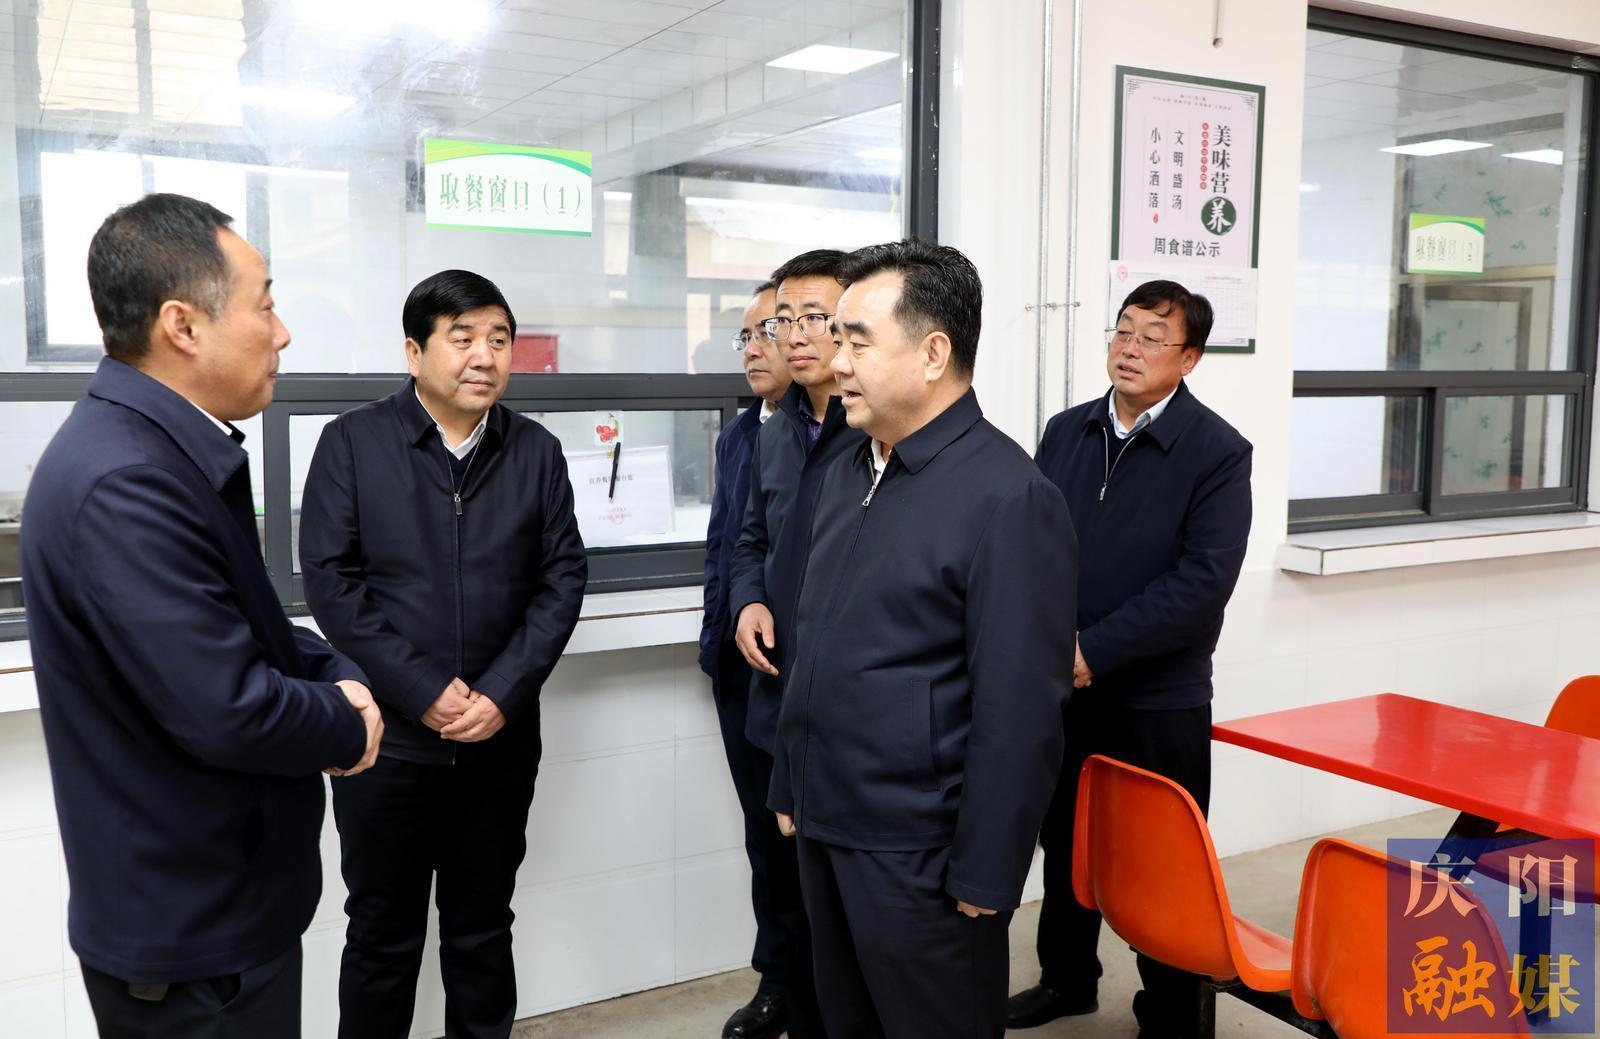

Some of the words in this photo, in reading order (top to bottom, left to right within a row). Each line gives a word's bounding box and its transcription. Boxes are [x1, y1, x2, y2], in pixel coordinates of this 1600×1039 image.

[1149, 127, 1161, 208] 小心洒落
[1172, 130, 1185, 210] 文明盛汤
[1206, 124, 1232, 234] 美味营养
[1154, 237, 1221, 258] 周食谱公示
